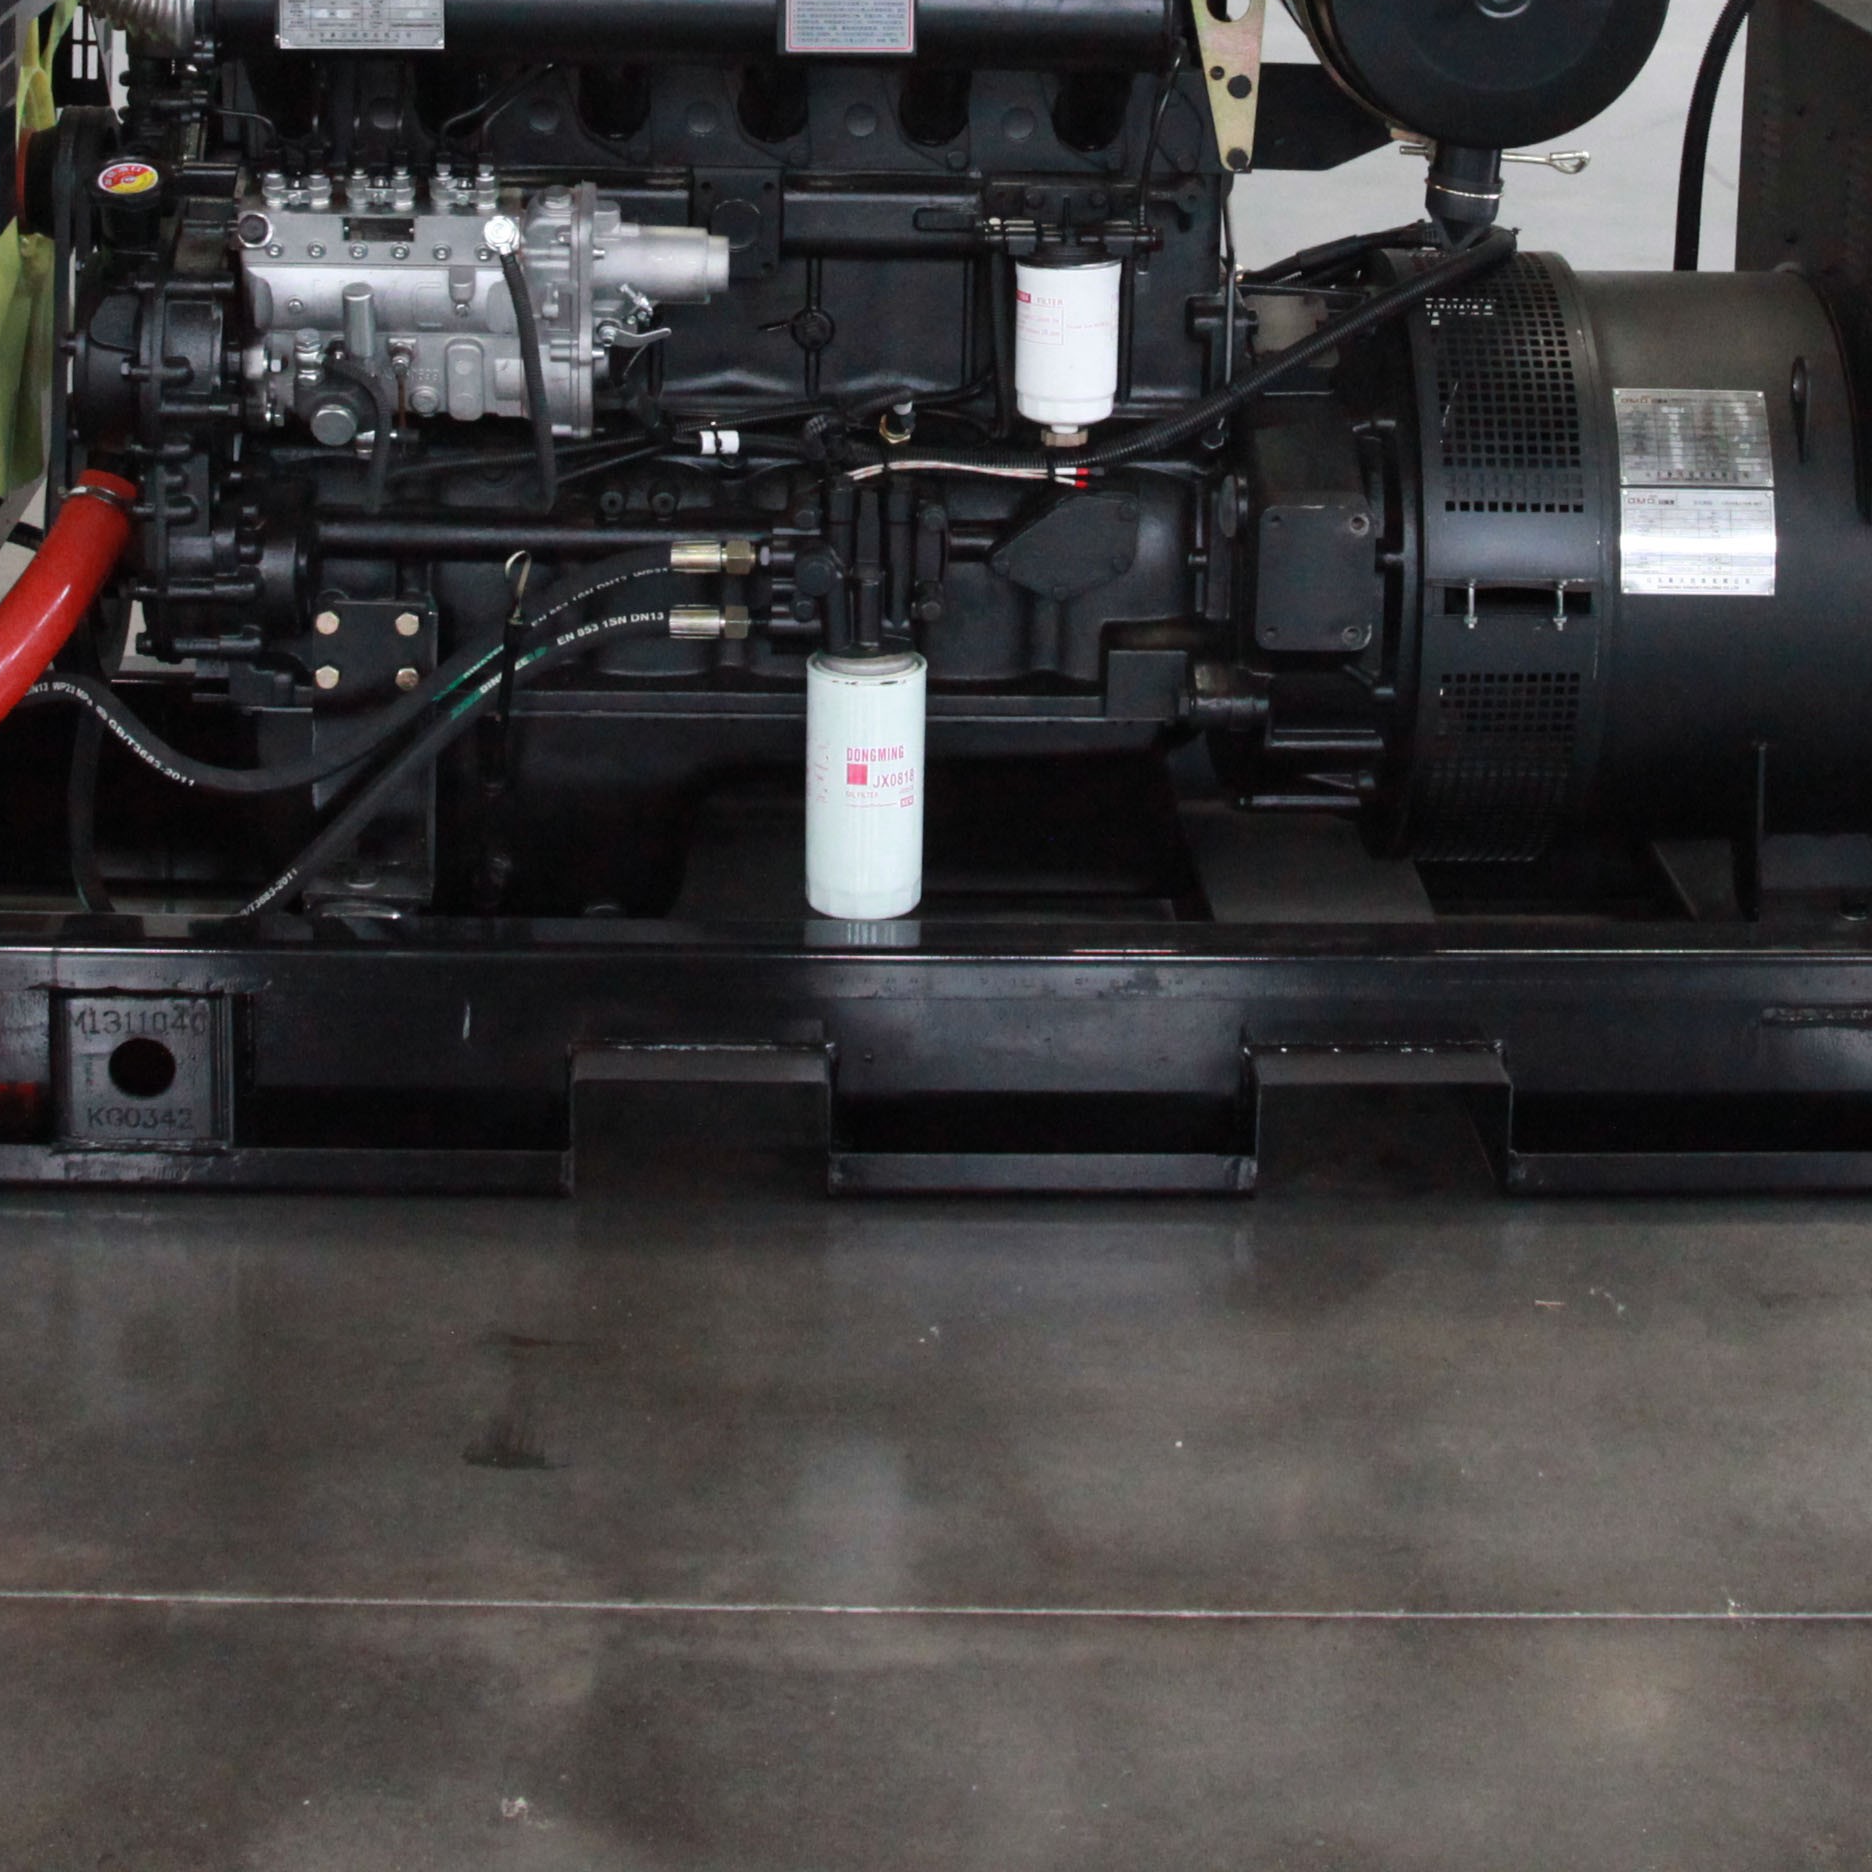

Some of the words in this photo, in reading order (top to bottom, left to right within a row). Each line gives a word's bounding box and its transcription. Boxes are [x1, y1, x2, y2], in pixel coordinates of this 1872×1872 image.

[556, 631, 575, 647] EN
[577, 624, 599, 638] 853
[602, 615, 628, 629] 1SN
[630, 611, 665, 622] DN13
[846, 745, 905, 762] DONGMING
